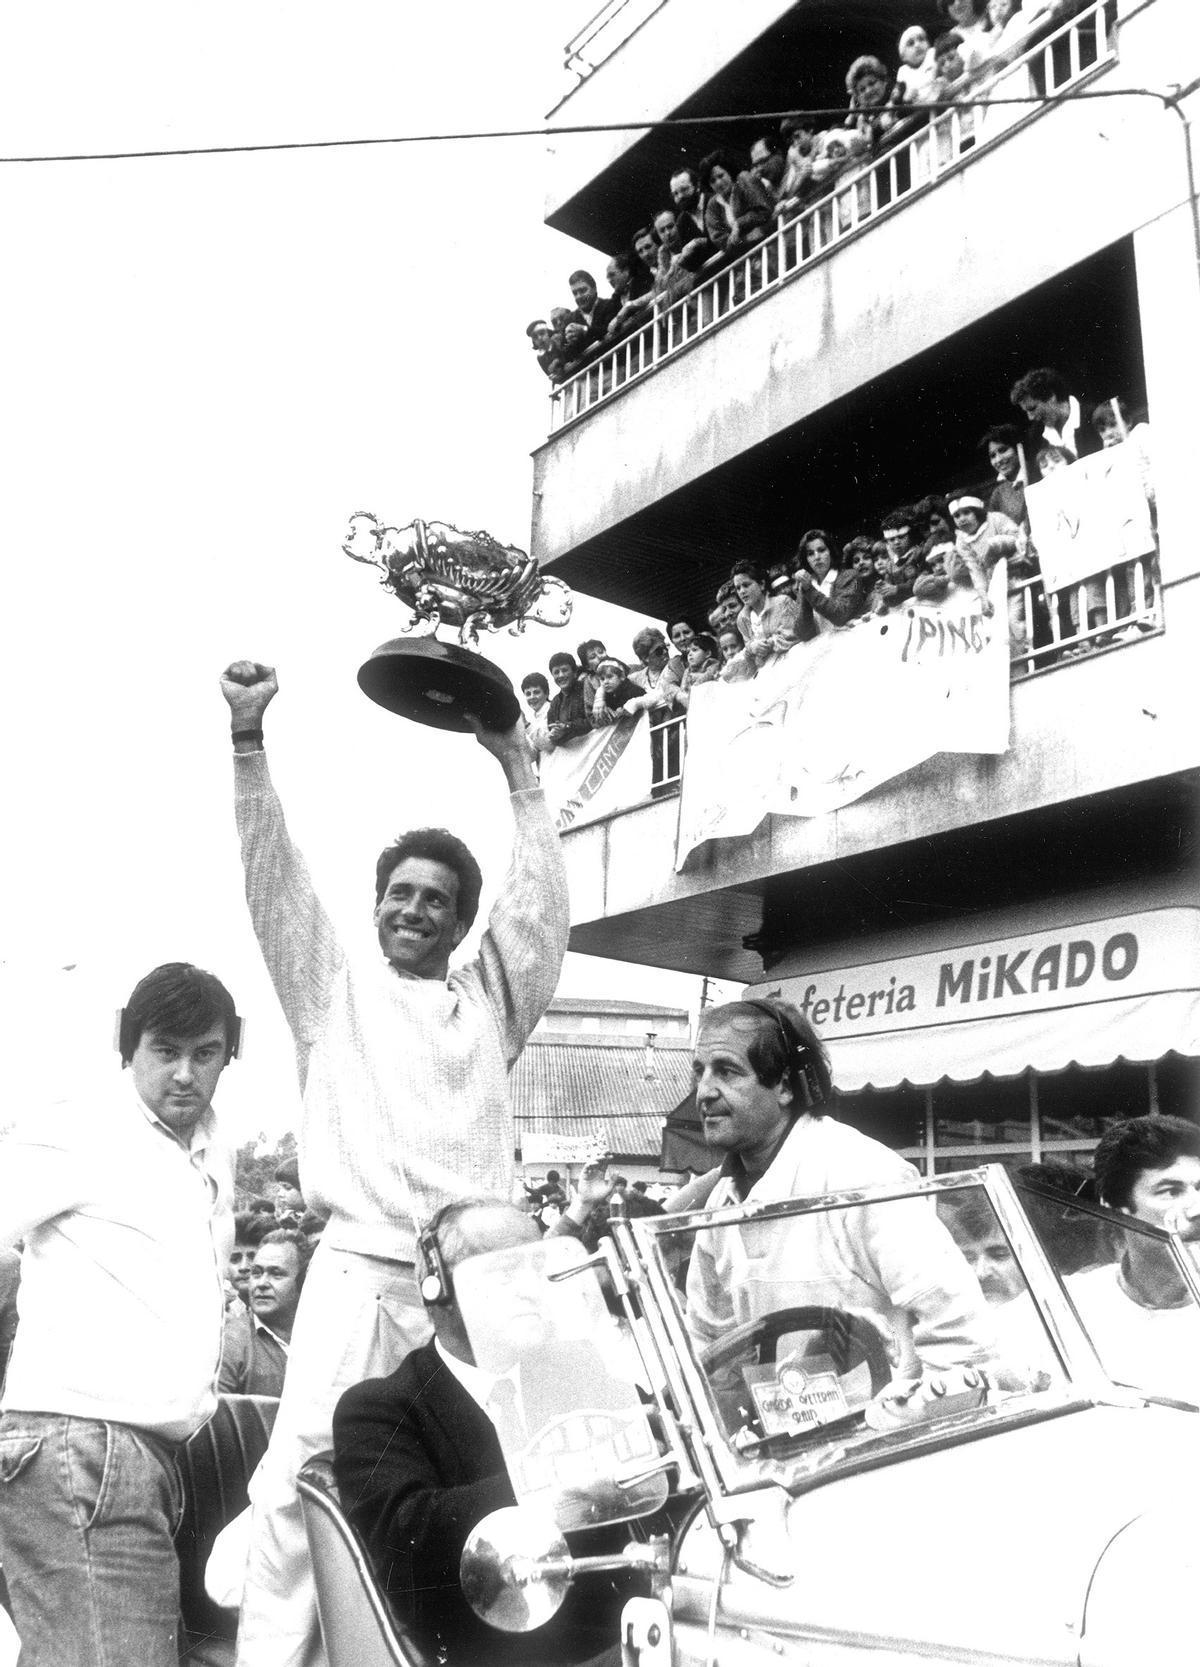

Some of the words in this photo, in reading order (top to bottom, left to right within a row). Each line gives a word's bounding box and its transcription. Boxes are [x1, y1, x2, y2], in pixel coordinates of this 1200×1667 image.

[764, 975, 917, 1026] feteria
[935, 932, 1139, 1008] MiKADO
[799, 1391, 840, 1405] VETERAN
[792, 1409, 818, 1424] RAID
